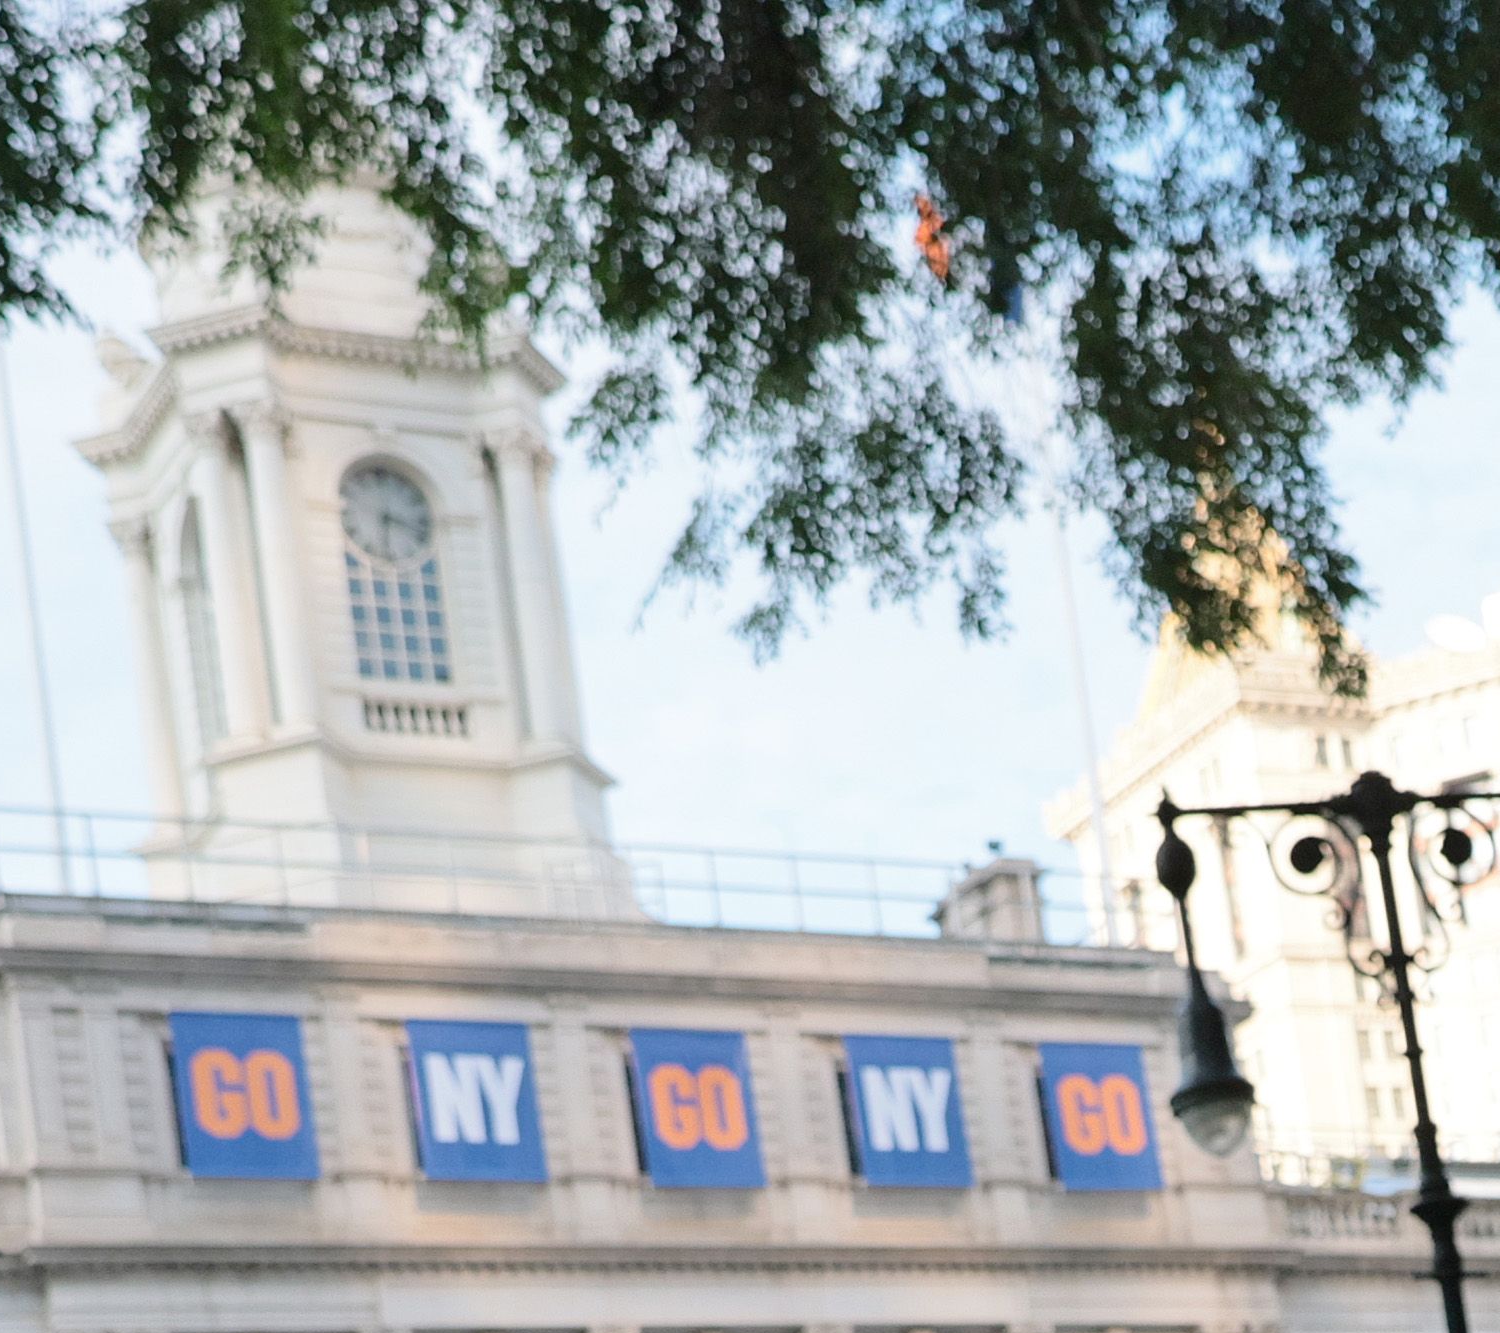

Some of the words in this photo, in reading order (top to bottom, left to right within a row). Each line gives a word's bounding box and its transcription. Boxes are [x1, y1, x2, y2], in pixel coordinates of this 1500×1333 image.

[189, 1048, 300, 1141] GO
[421, 1051, 526, 1146] NY
[651, 1063, 750, 1152] GO
[859, 1064, 953, 1154] NY
[1055, 1074, 1147, 1156] GO
